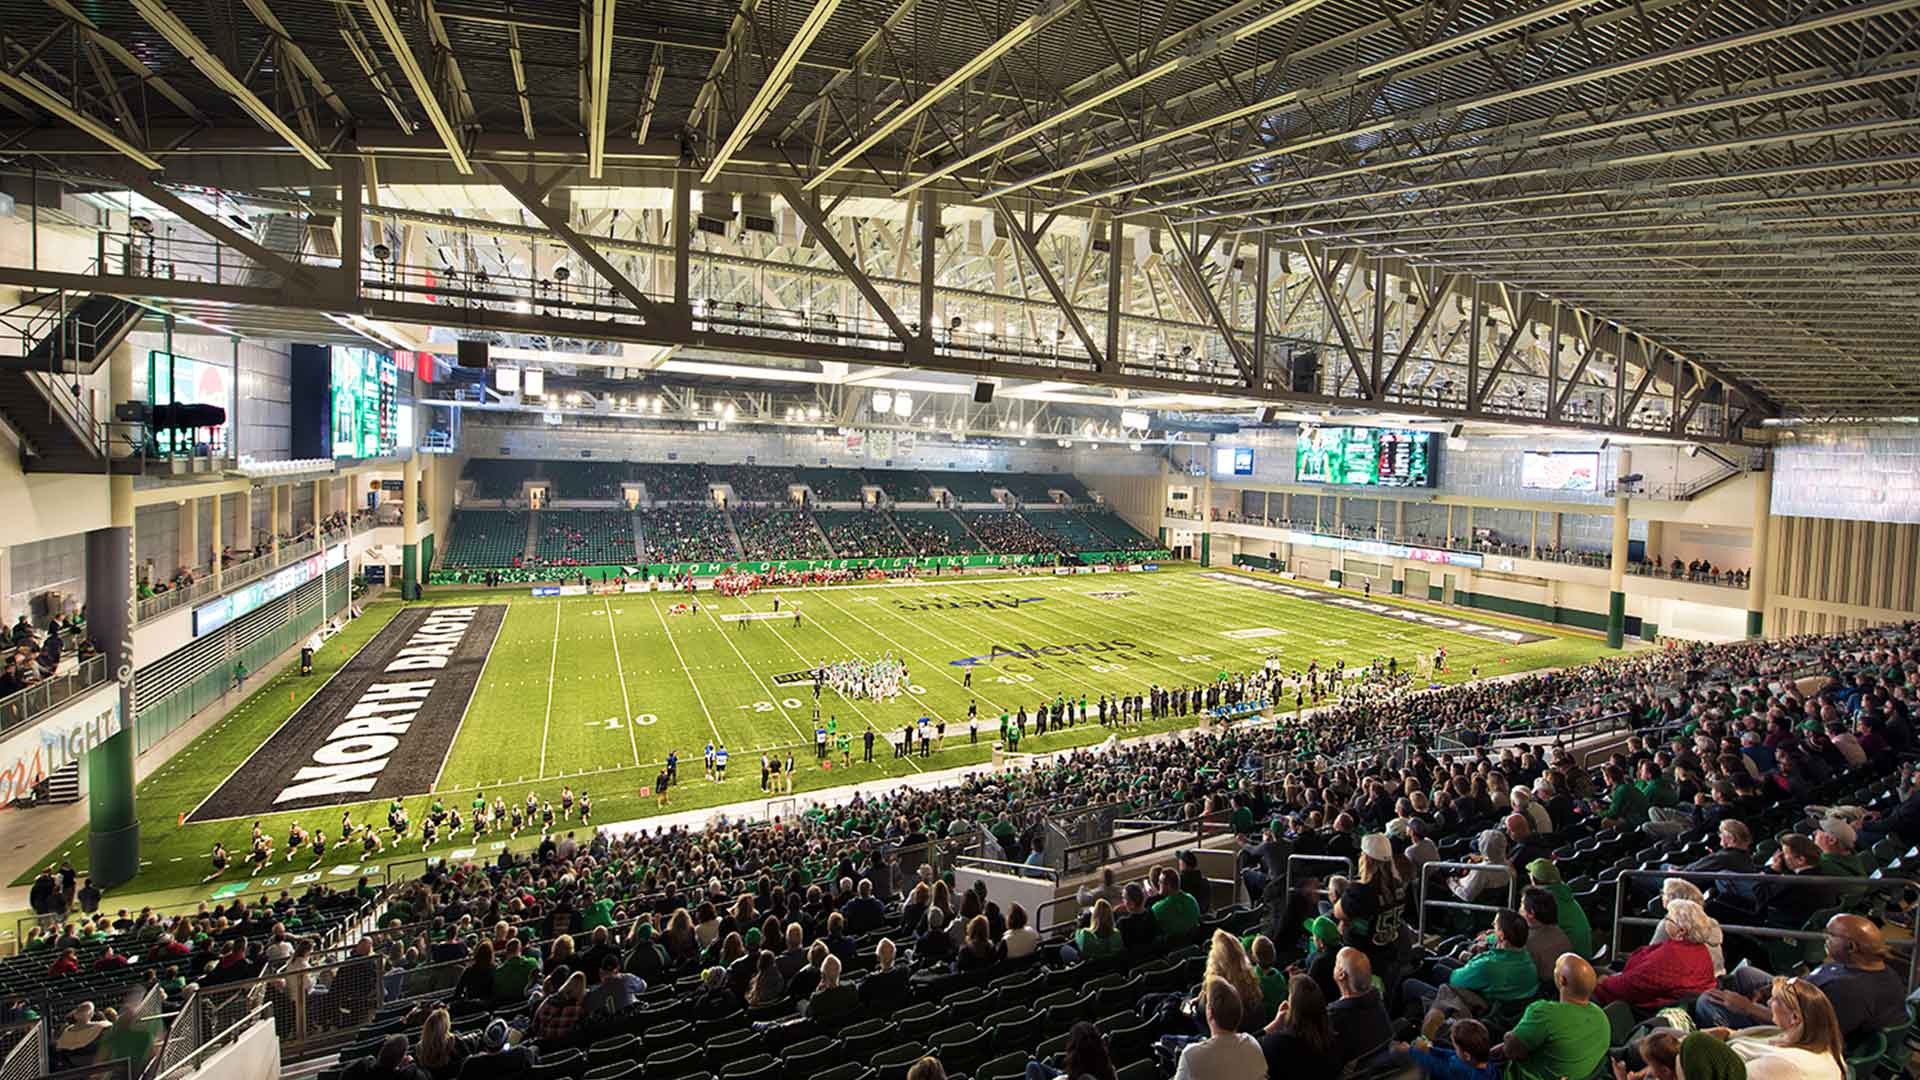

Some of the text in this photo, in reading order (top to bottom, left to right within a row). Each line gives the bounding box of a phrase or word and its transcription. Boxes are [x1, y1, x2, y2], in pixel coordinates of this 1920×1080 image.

[669, 563, 738, 575] HOME
[808, 560, 848, 570] THE
[990, 639, 1137, 661] Alerus
[272, 607, 478, 805] NORTH DAKOTA
[753, 697, 802, 713] 20
[604, 713, 657, 730] 10
[46, 707, 113, 776] LIGHT
